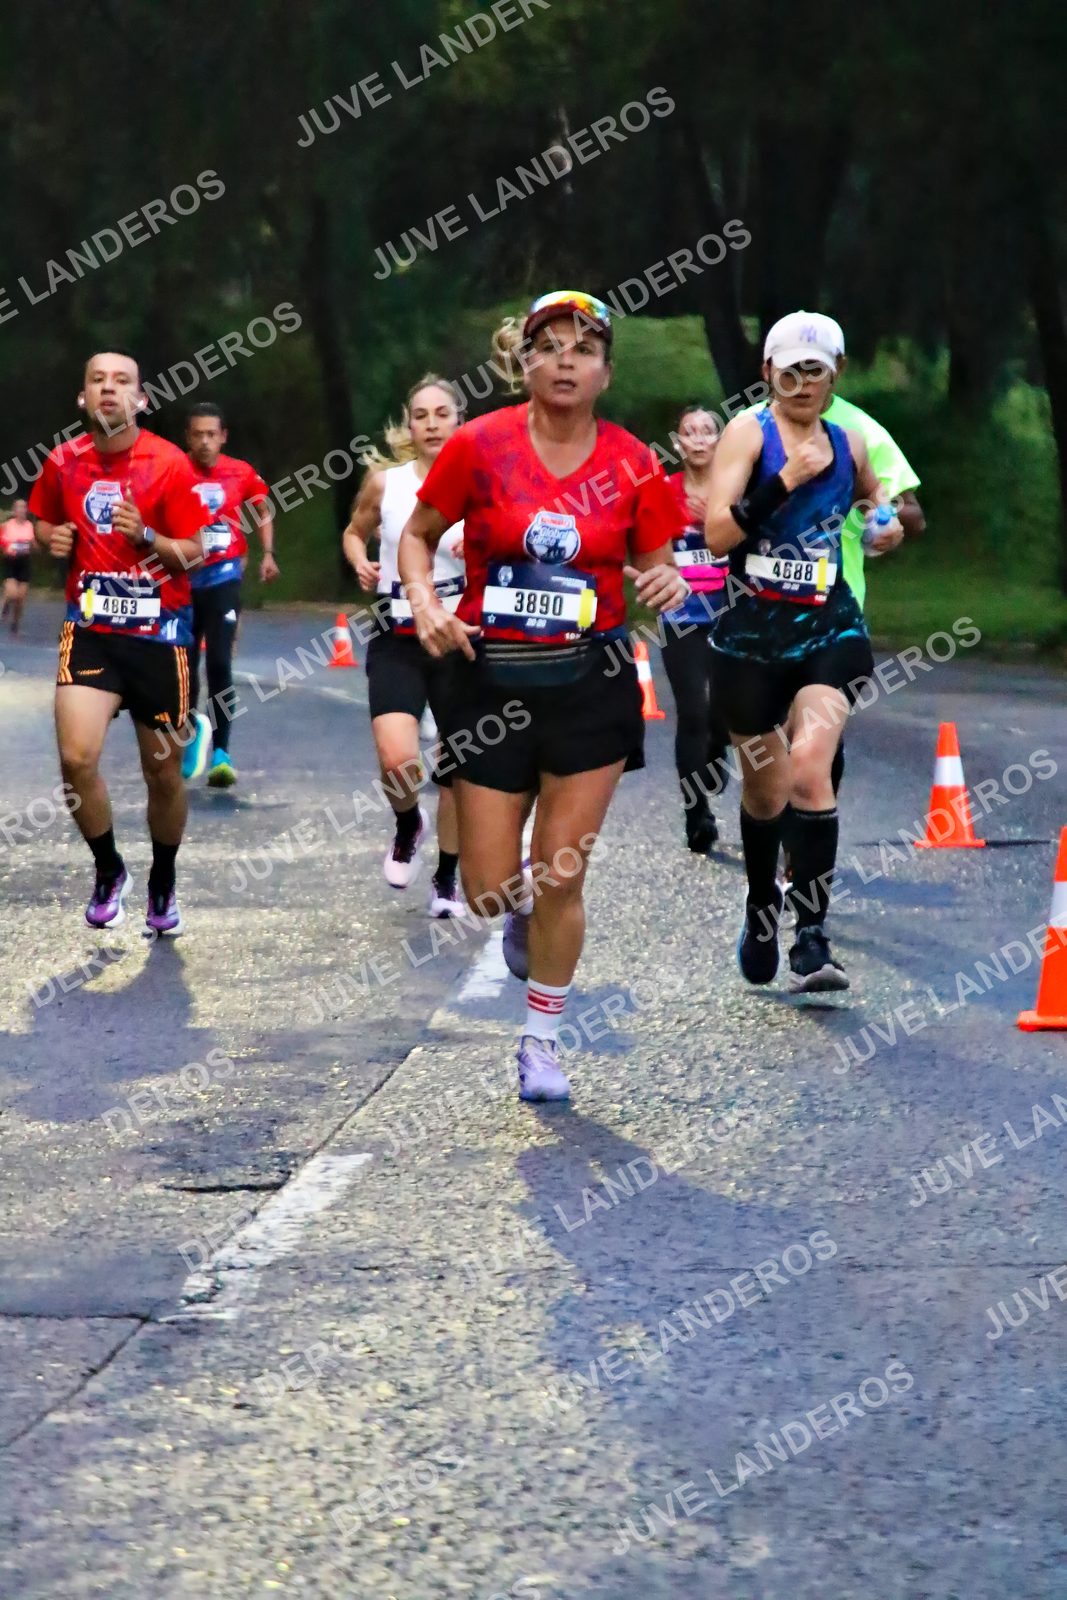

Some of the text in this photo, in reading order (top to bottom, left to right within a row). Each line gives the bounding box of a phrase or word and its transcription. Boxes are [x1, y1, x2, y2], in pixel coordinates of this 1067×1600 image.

[773, 561, 813, 581] 4688
[103, 599, 137, 615] 4863
[514, 592, 563, 616] 3890
